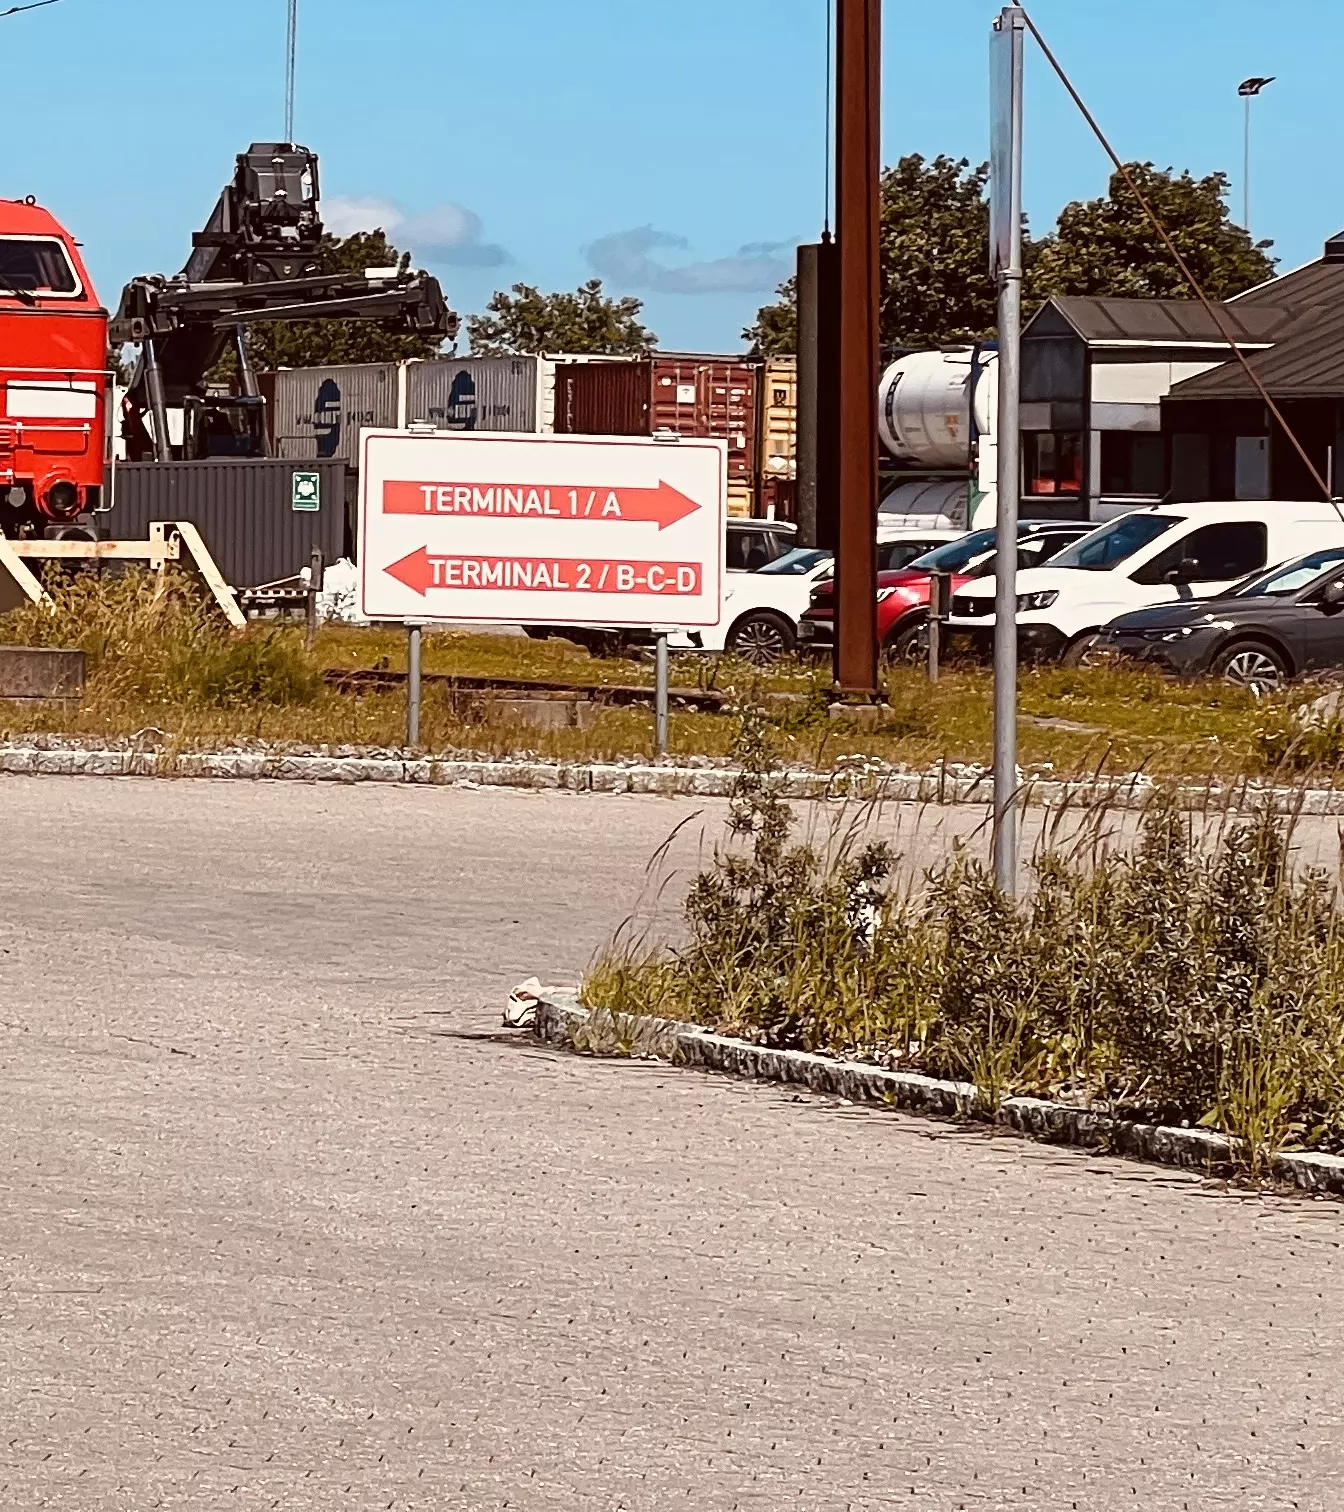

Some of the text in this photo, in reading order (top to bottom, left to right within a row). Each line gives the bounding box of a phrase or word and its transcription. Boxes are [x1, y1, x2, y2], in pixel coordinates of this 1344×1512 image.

[419, 485, 622, 517] TERMINAL 1 / A
[427, 559, 697, 592] TERMINAL 2 / B-C-D
